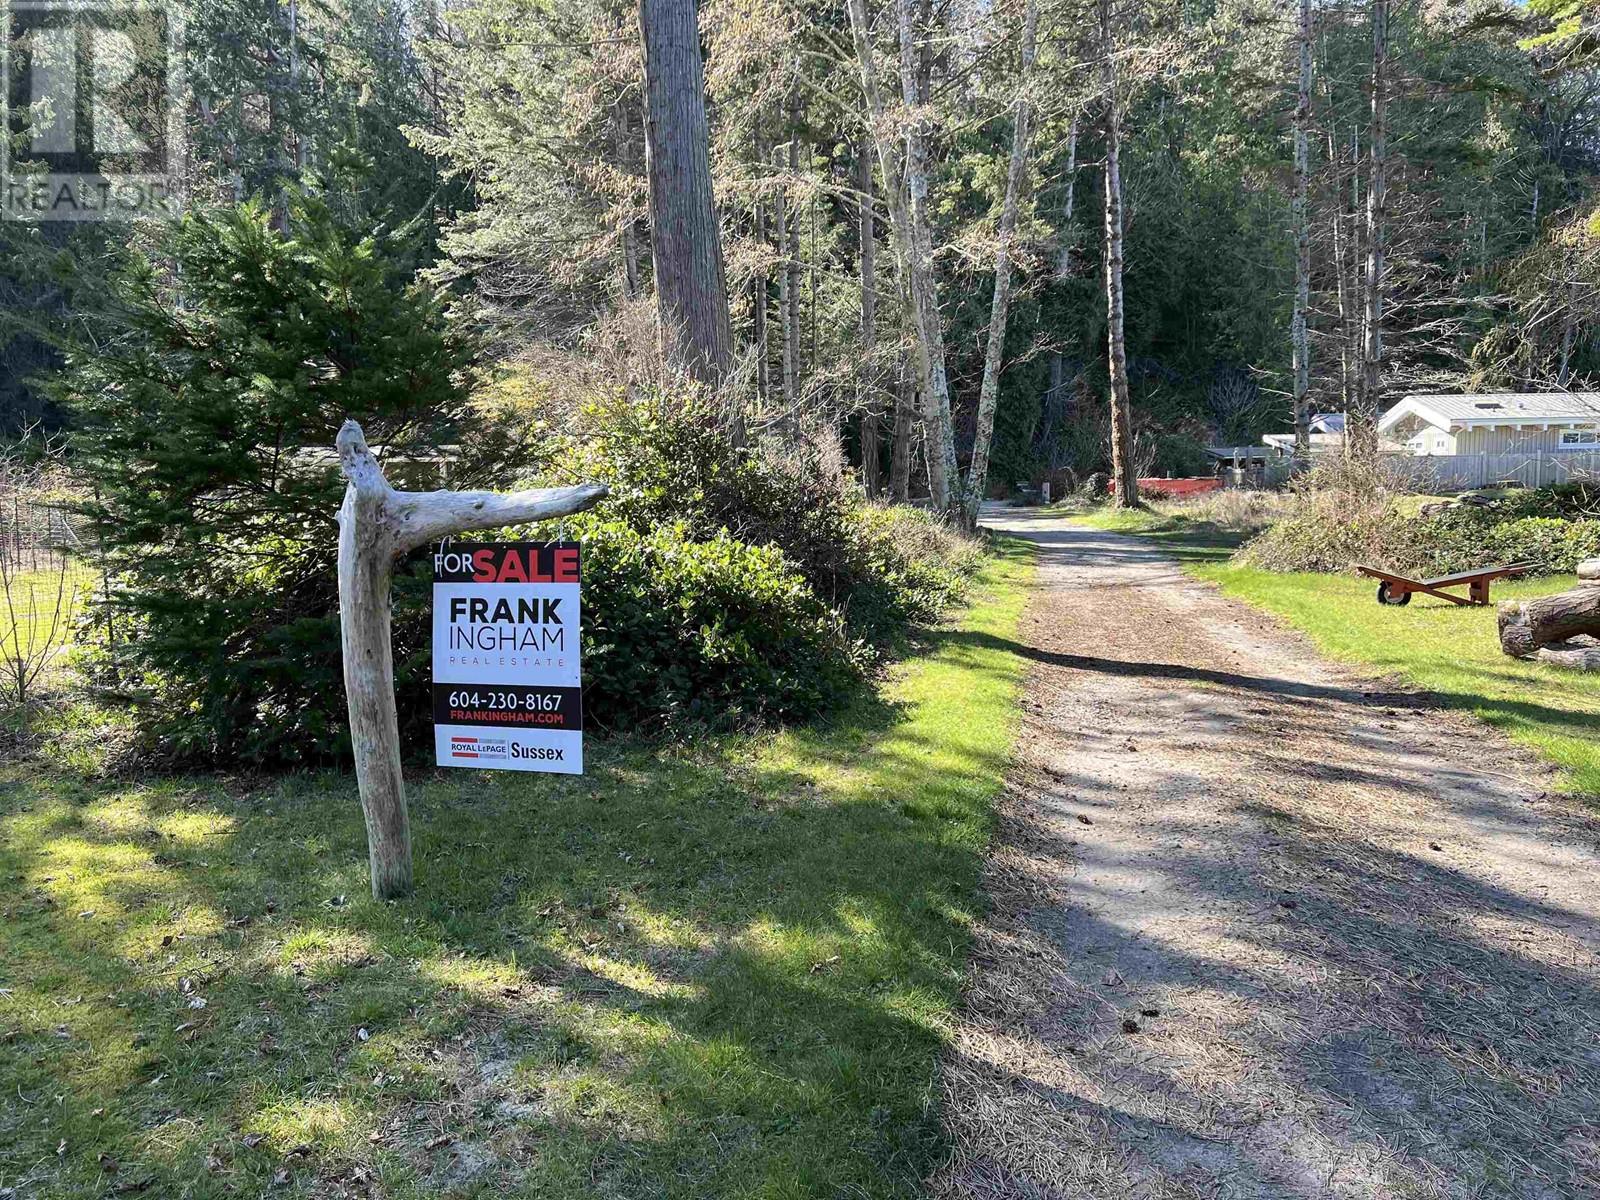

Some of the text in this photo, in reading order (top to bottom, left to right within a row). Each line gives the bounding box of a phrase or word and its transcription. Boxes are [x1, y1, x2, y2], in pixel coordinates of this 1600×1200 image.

[434, 549, 578, 583] FOR SALE
[450, 598, 562, 624] FRANK
[449, 626, 564, 651] INGHAM
[450, 656, 564, 667] REAL ESTATE
[449, 691, 562, 711] 604-230-8167
[450, 711, 563, 724] FRANKINGHAM.COM
[451, 743, 476, 752] ROYAL
[511, 742, 564, 761] Sussex
